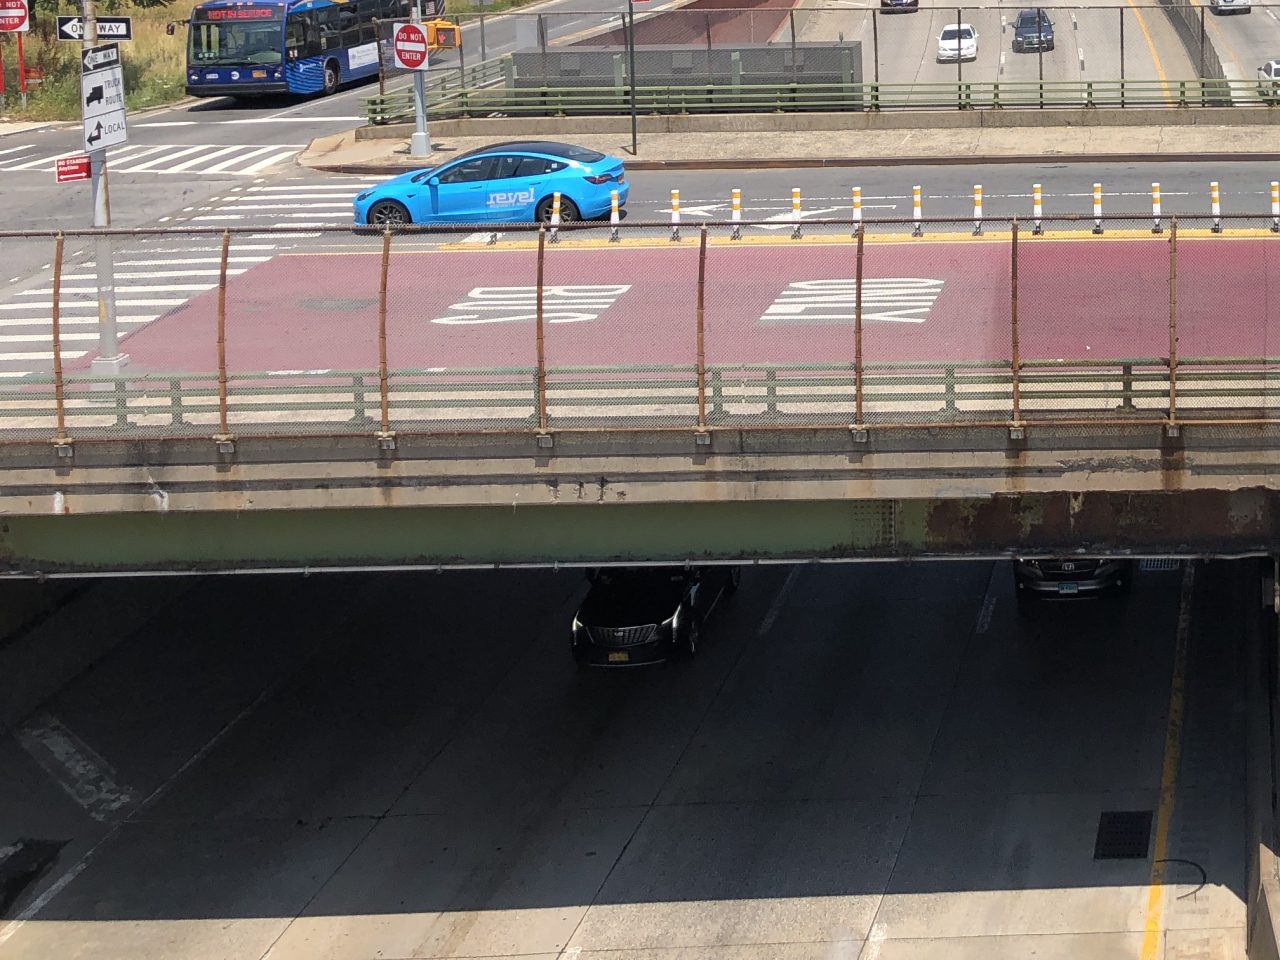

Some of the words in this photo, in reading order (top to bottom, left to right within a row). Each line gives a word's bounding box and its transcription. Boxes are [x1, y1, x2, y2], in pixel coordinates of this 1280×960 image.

[99, 24, 120, 33] WAY
[398, 32, 407, 40] DO
[410, 33, 422, 41] NOT
[87, 53, 99, 64] ONE
[102, 49, 115, 59] WAY
[401, 51, 421, 60] ENTER
[104, 77, 121, 89] TRUCK
[105, 93, 122, 106] ROUTE
[104, 121, 125, 135] LOCAL
[486, 187, 535, 205] revel
